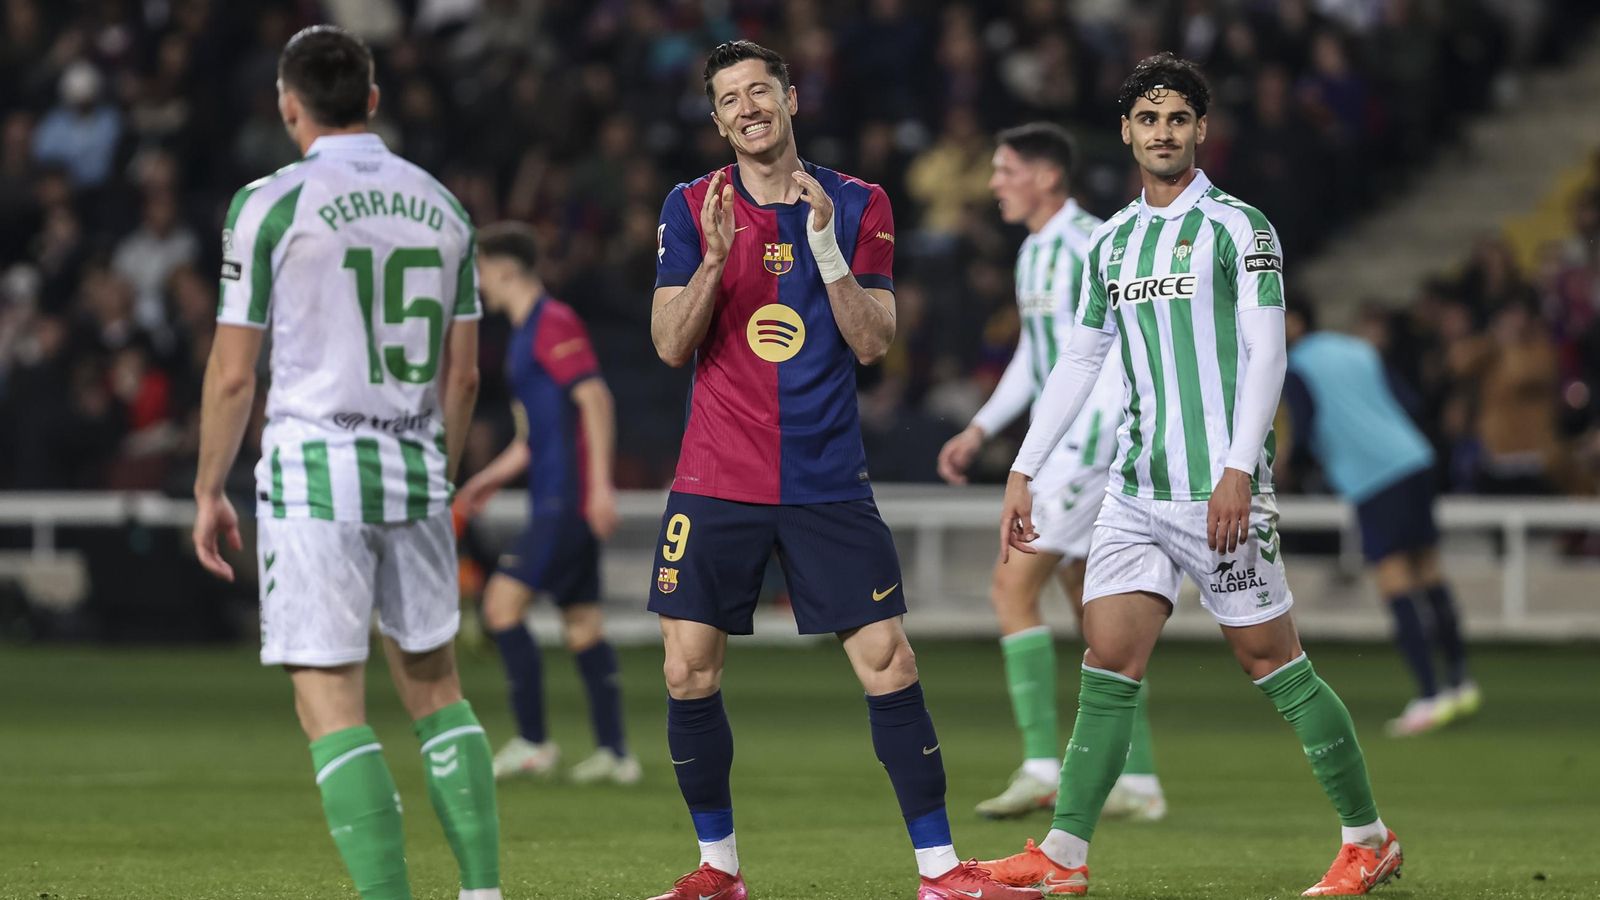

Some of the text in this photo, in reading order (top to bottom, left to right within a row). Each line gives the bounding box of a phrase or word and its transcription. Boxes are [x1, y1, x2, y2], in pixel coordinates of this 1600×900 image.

[318, 190, 444, 231] PERRAUD
[1254, 230, 1275, 252] R
[1246, 258, 1281, 269] REVEL
[1124, 276, 1196, 301] GREE
[342, 247, 444, 385] 15
[662, 513, 691, 562] 9
[1210, 577, 1267, 593] GLOBAL
[1226, 568, 1256, 582] AUS
